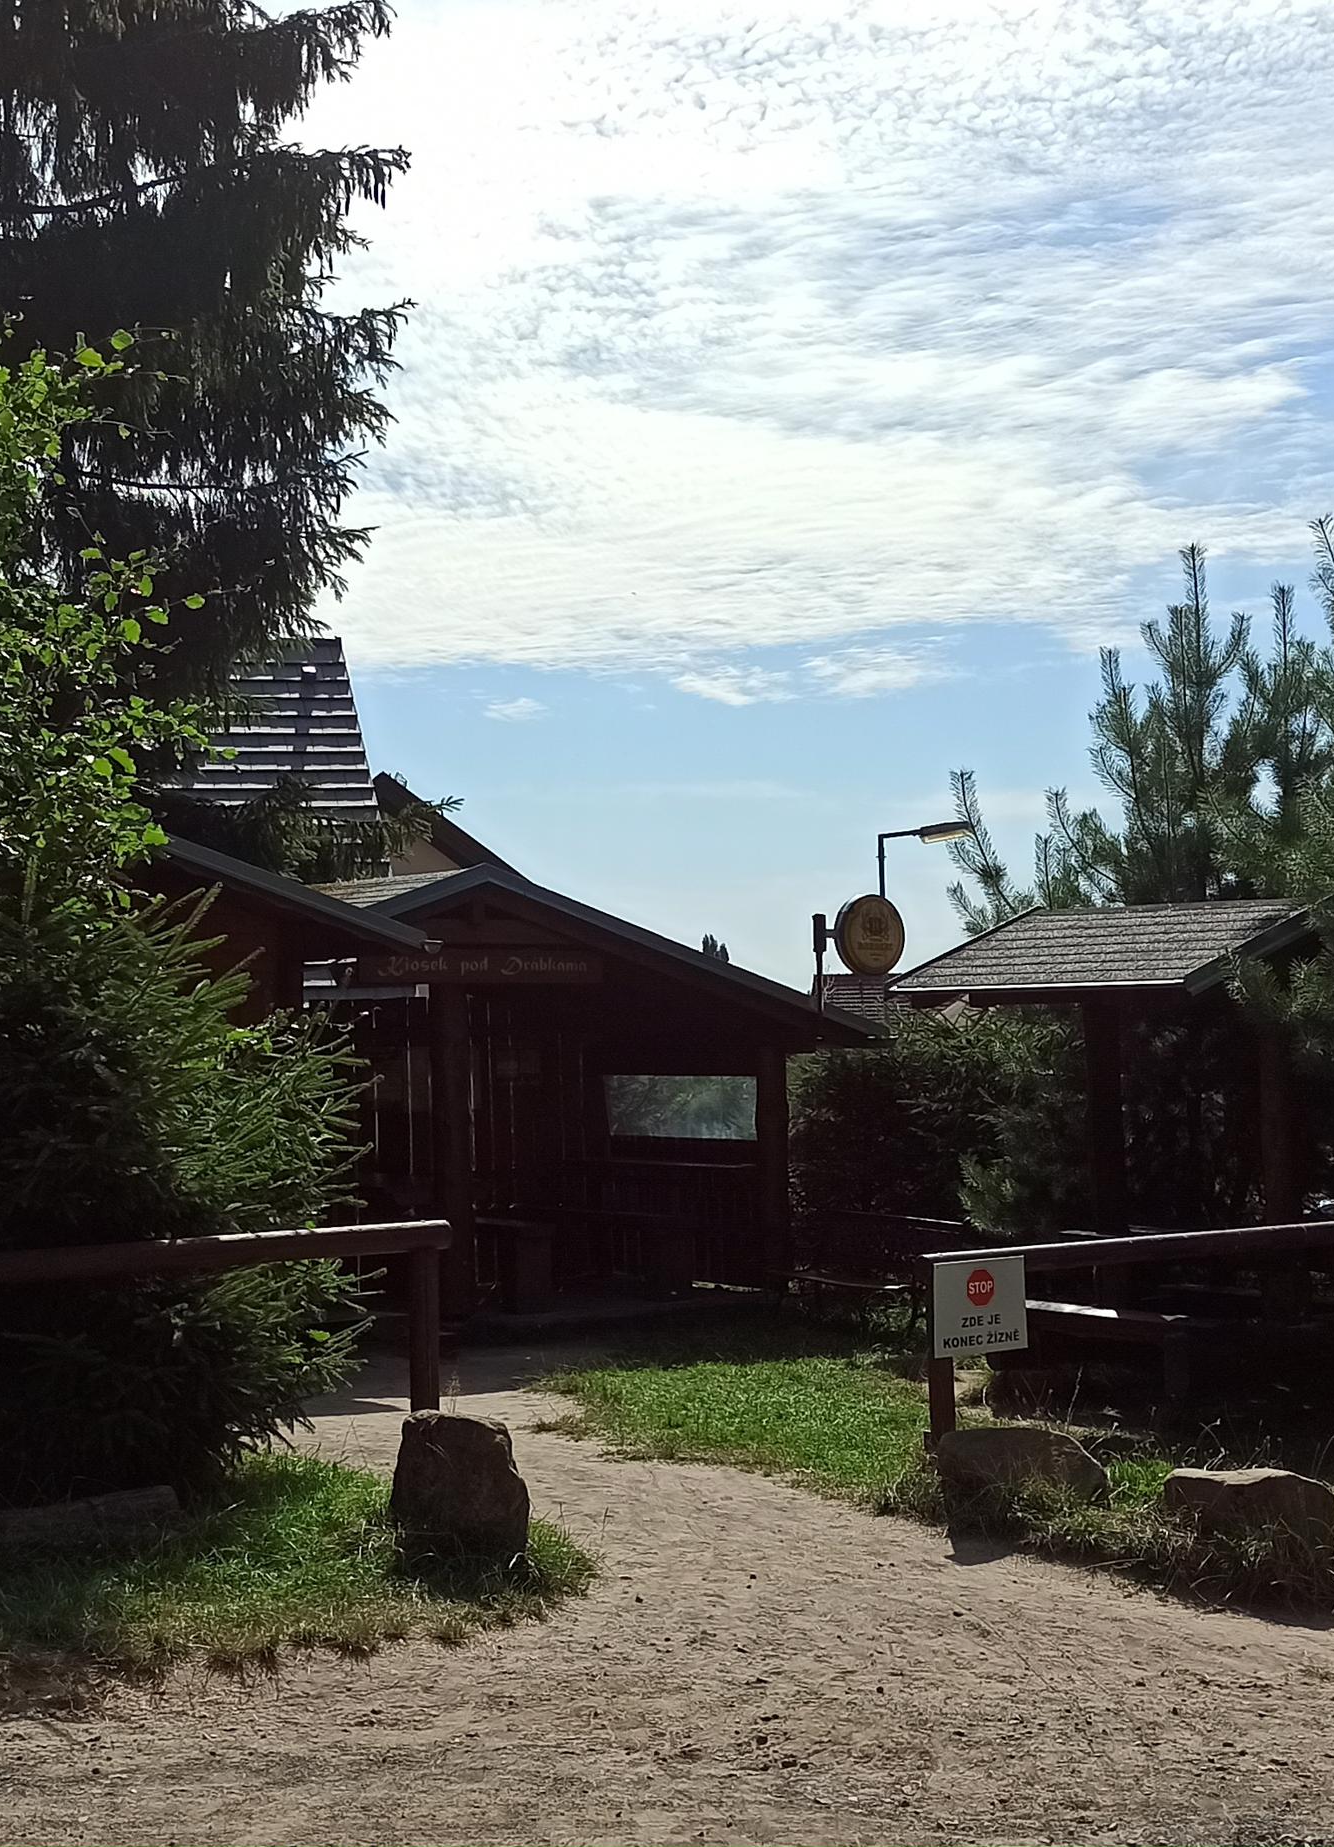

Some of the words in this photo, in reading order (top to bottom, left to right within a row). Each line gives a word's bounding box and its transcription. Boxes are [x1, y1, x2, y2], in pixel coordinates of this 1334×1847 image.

[460, 956, 489, 977] pod
[968, 1281, 994, 1294] STOP
[962, 1316, 984, 1328] ZDE
[988, 1314, 1001, 1325] JE
[943, 1335, 983, 1348] KONEC
[987, 1329, 1019, 1344] ŽÍZNĚ
